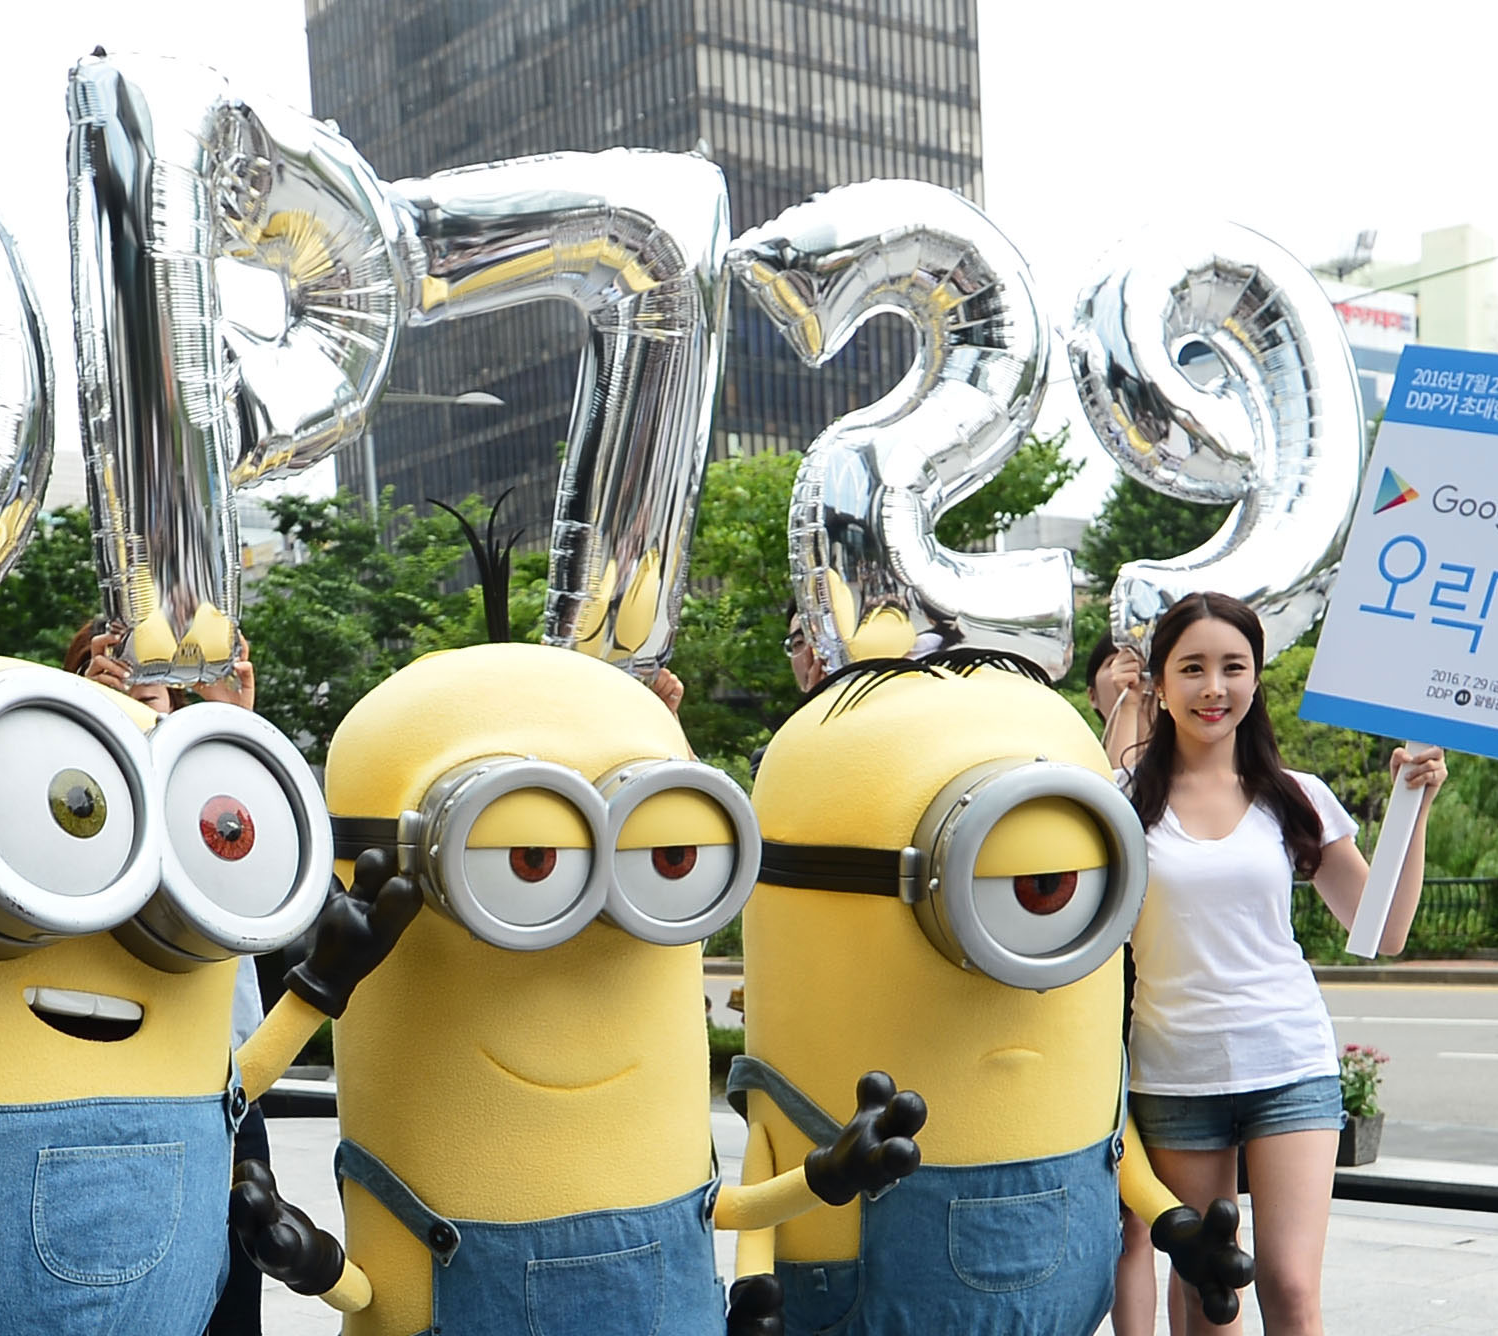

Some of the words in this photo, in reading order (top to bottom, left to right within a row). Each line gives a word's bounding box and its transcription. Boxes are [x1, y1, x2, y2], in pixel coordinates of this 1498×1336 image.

[1412, 368, 1464, 391] 2016년
[1466, 373, 1490, 395] 7월
[1405, 390, 1459, 416] DDP가
[1426, 685, 1453, 700] DDP
